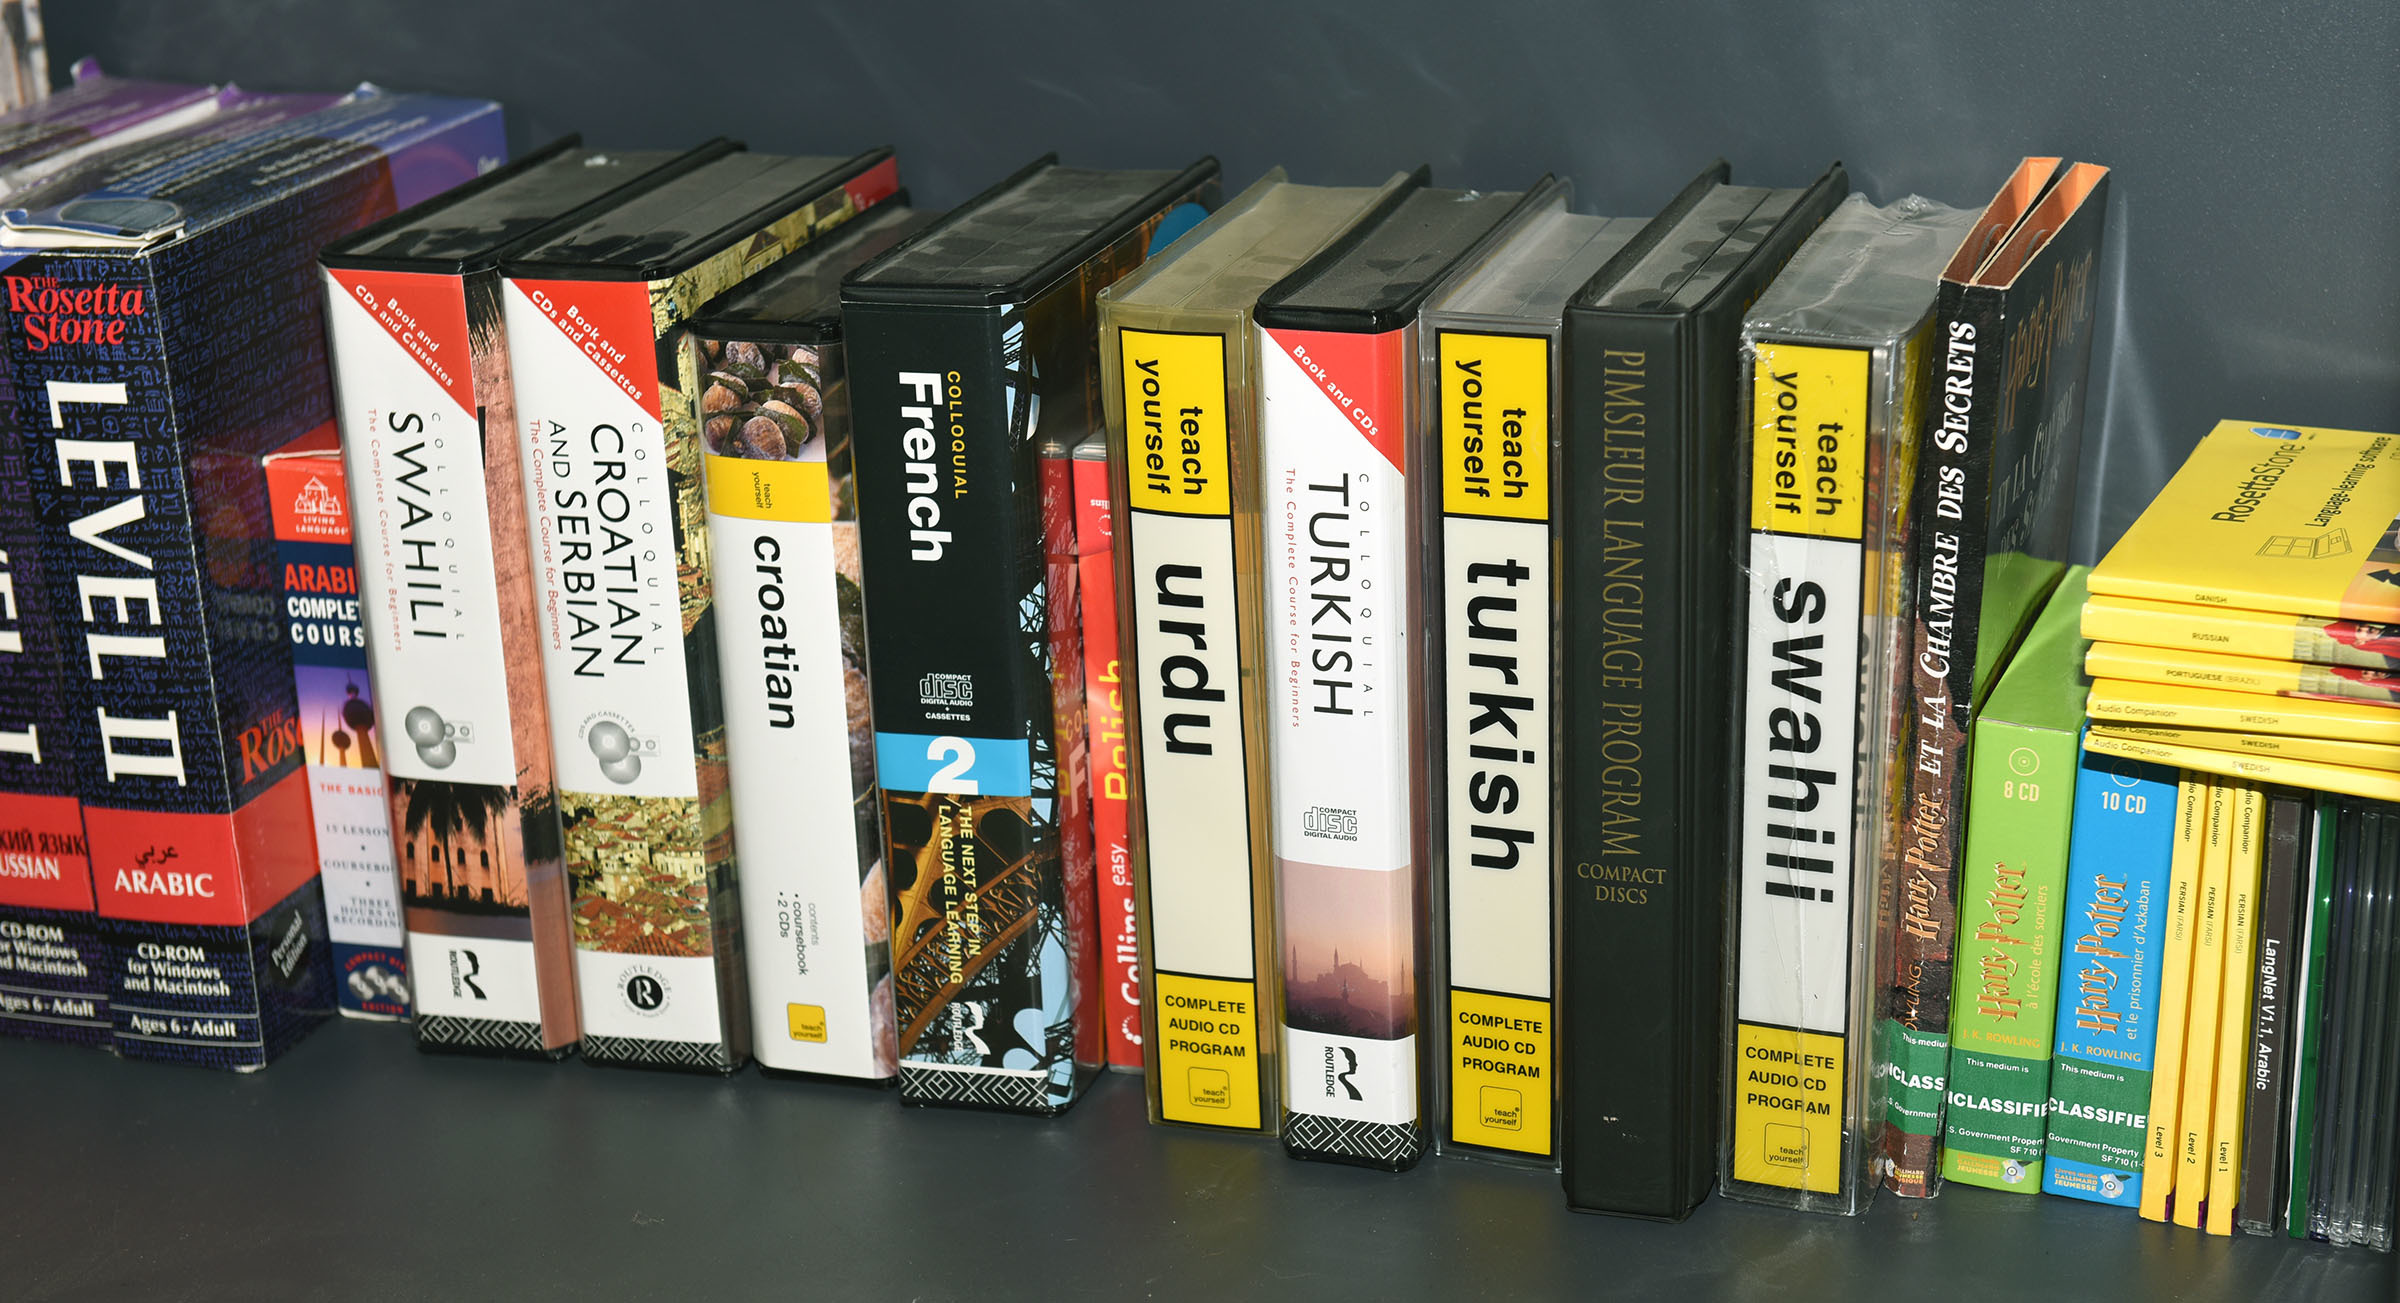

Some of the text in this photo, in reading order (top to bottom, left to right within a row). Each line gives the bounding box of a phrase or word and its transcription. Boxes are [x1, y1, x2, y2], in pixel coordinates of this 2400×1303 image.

[3, 275, 146, 316] Rosetta
[30, 276, 60, 289] THE
[24, 312, 126, 351] Stone
[355, 284, 454, 387] CDs and Cassettes
[387, 297, 440, 353] Book and
[566, 305, 626, 364] Book and
[532, 290, 643, 400] CDs and Cassettes
[1292, 345, 1380, 438] Book and CDs
[947, 370, 968, 500] COLLOQUIAL
[1135, 358, 1171, 494] yourself
[1455, 358, 1490, 498] yourself
[1773, 371, 1802, 515] yourself
[899, 371, 952, 562] French
[1179, 406, 1207, 496] teach
[1502, 407, 1529, 498] teach
[1815, 421, 1844, 517] teach
[751, 471, 764, 509] yourself
[763, 482, 773, 509] teach
[2211, 443, 2305, 523] RosettaStone
[2304, 436, 2392, 527] Language-learning software
[303, 516, 335, 525] LIVING
[388, 411, 447, 638] SWAHILI
[431, 412, 465, 640] COLLOQUIAL
[529, 419, 561, 651] The Complete Course for Beginners
[631, 422, 664, 655] COLLOQUIAL
[548, 420, 605, 678] AND SERBIAN
[590, 423, 646, 665] CROATIAN
[46, 380, 187, 787] LEVEL II
[284, 563, 356, 594] ARABI
[1284, 468, 1301, 728] The Complete Course for Beginners
[1308, 472, 1353, 716] TURKISH
[1359, 473, 1373, 716] COLLOQUIAL
[287, 596, 360, 621] COMPLE
[1601, 348, 1646, 857] PIMSLEUR LANGUAGE PROGRAM
[2195, 594, 2228, 604] DANISH
[291, 622, 365, 648] COURS
[753, 535, 800, 729] croatian
[1905, 320, 1977, 942] Harry Potter ET LA CHAMBRE DES SECRETS
[2192, 632, 2230, 643] RUSSIAN
[935, 673, 972, 681] COMPACT
[1155, 563, 1226, 756] urdu
[2166, 669, 2223, 682] PORTUGUESE
[919, 673, 973, 699] disc
[920, 698, 973, 707] DIGITAL AUDIO
[925, 712, 971, 721] CASSETTES
[1466, 558, 1535, 870] turkish
[1765, 576, 1837, 903] swahili
[927, 735, 979, 795] 2
[2004, 780, 2040, 802] 8 CD
[2101, 791, 2147, 815] 10 CD
[1303, 806, 1358, 835] disc
[1318, 807, 1357, 816] COMPACT
[1303, 831, 1358, 842] DIGITAL AUDIO
[135, 845, 179, 868] عربي
[1112, 843, 1129, 886] easy
[1577, 863, 1667, 884] COMPACT
[115, 868, 215, 898] ARABIC
[938, 805, 963, 984] LANGUAGE LEARNING
[959, 806, 981, 956] THE NEXT STEP IN
[1594, 885, 1648, 904] DISCS
[2178, 881, 2187, 914] PERSIAN
[777, 899, 790, 938] 2 CDs
[2207, 886, 2216, 919] PERSIAN
[2236, 893, 2246, 927] PERSIAN
[137, 943, 205, 963] CD-ROM
[792, 900, 808, 976] coursebook
[1975, 861, 2034, 1023] Harry Potter
[2026, 884, 2049, 1010] à l'école des sorciers
[2074, 873, 2134, 1036] Harry Potter
[128, 957, 221, 980] for Windows
[2126, 880, 2151, 1040] et le prisonnier d'Azkaban
[124, 976, 231, 997] and Macintosh
[1164, 994, 1247, 1014] COMPLETE
[131, 1015, 237, 1037] Ages 6 Adult
[951, 1002, 963, 1052] ROUTLEDGE
[1168, 1017, 1241, 1036] AUDIO CD
[1458, 1012, 1543, 1034] COMPLETE
[2256, 938, 2280, 1091] LangNet V1.1, Arabic
[1169, 1039, 1246, 1058] PROGRAM
[1462, 1035, 1536, 1055] AUDIO CD
[1745, 1046, 1835, 1070] COMPLETE
[1963, 1028, 2041, 1049] J. K. ROWLING
[1323, 1046, 1336, 1098] ROUTLEDGE
[1462, 1057, 1541, 1079] PROGRAM
[1748, 1070, 1826, 1093] AUDIO CD
[1747, 1092, 1831, 1116] PROGRAM
[2156, 1126, 2165, 1149] Level
[2187, 1132, 2197, 1155] Level
[2220, 1141, 2229, 1164] Level
